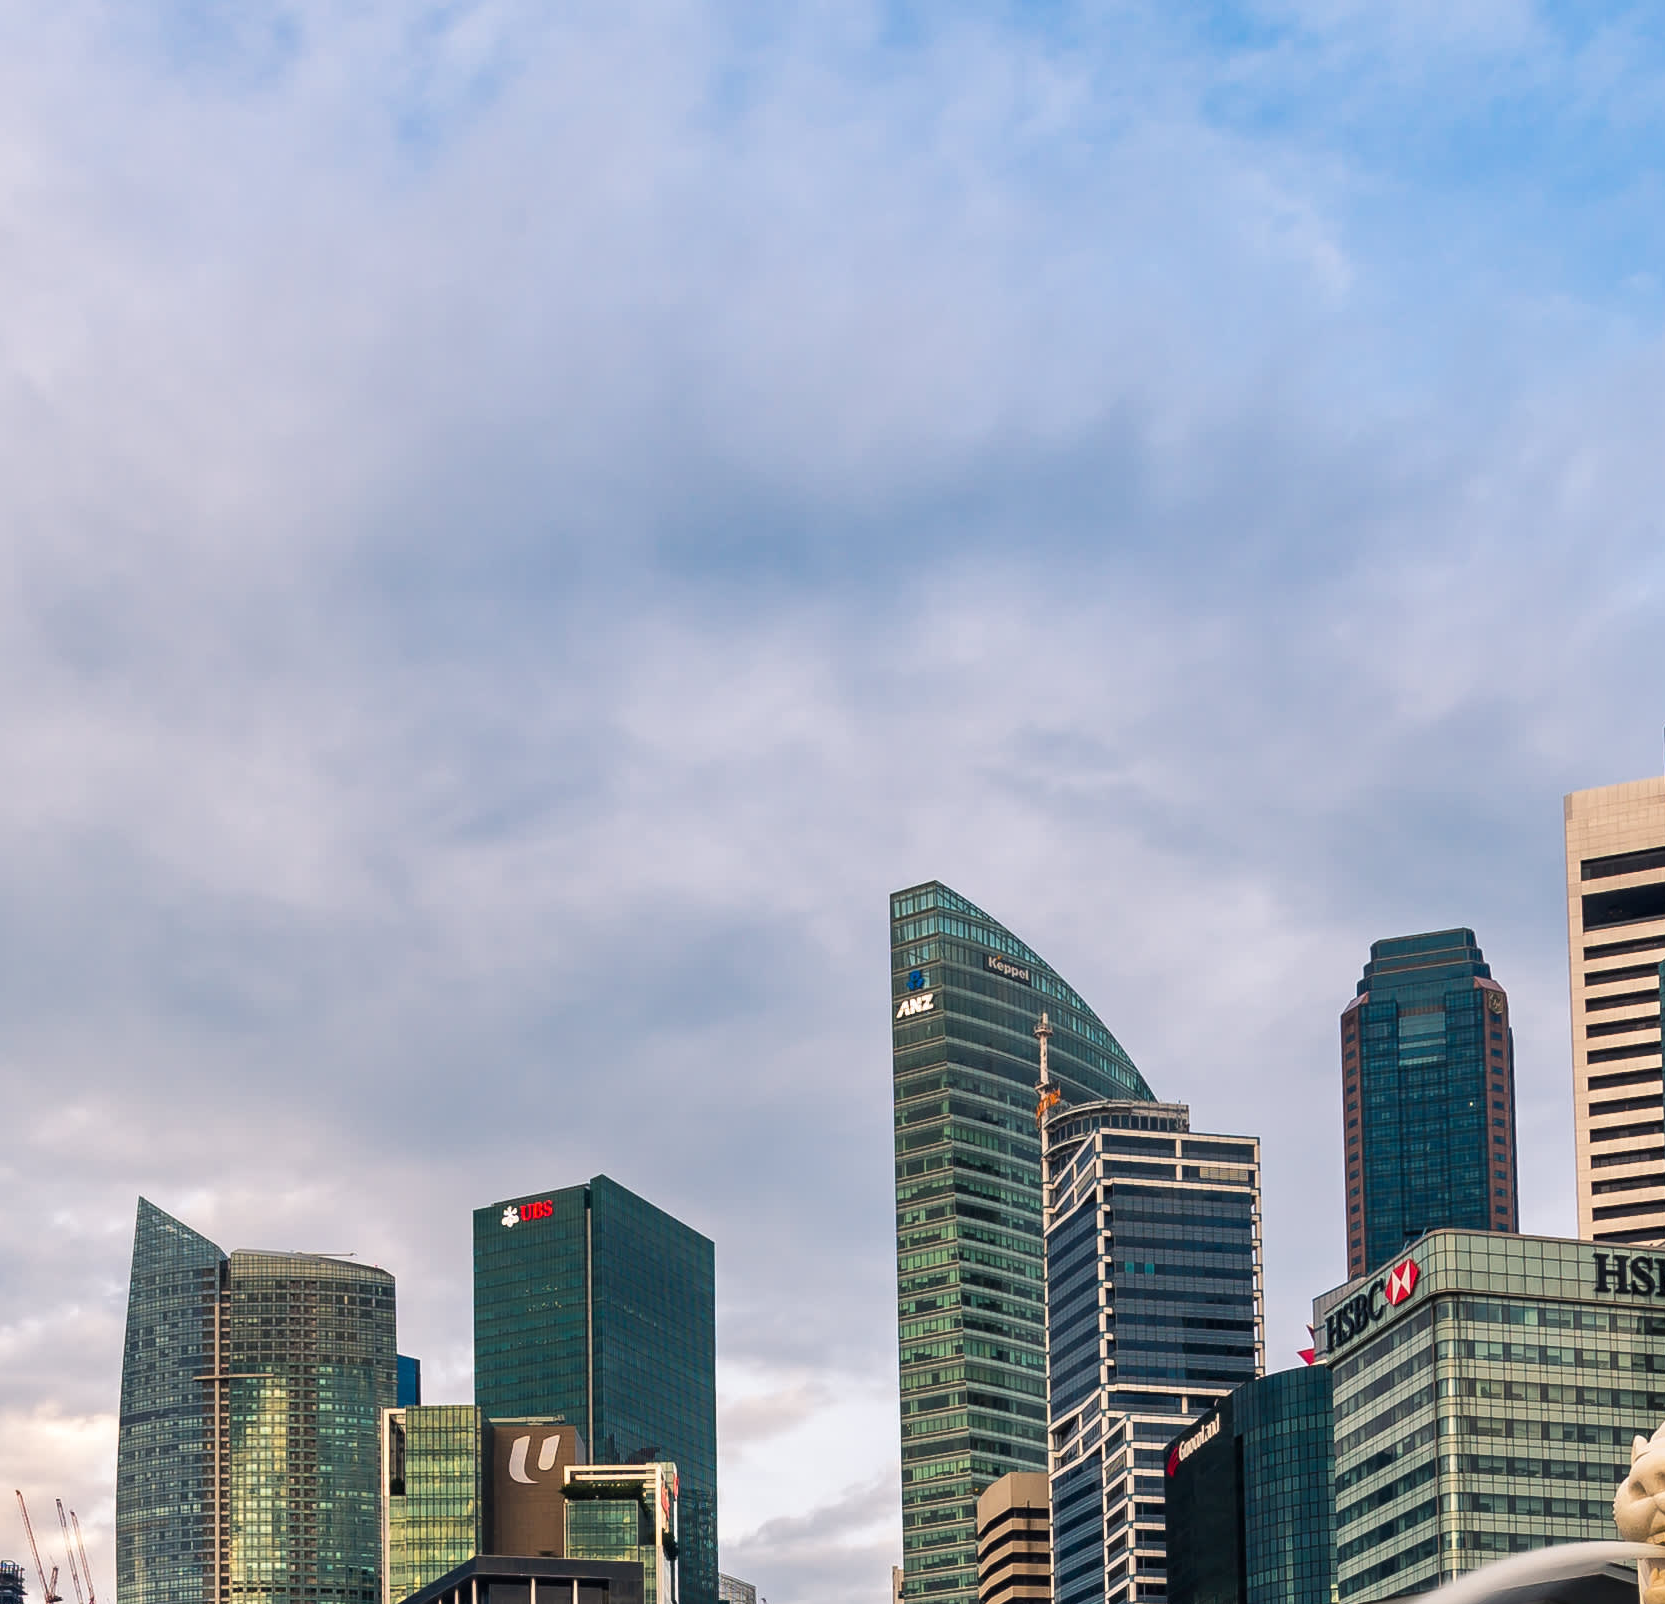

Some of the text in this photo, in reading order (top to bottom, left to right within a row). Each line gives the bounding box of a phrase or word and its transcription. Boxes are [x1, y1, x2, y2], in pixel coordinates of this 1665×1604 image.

[988, 955, 1030, 981] Keppel
[896, 993, 934, 1019] ANZ
[520, 1200, 554, 1221] UBS
[1325, 1278, 1385, 1354] HSBC
